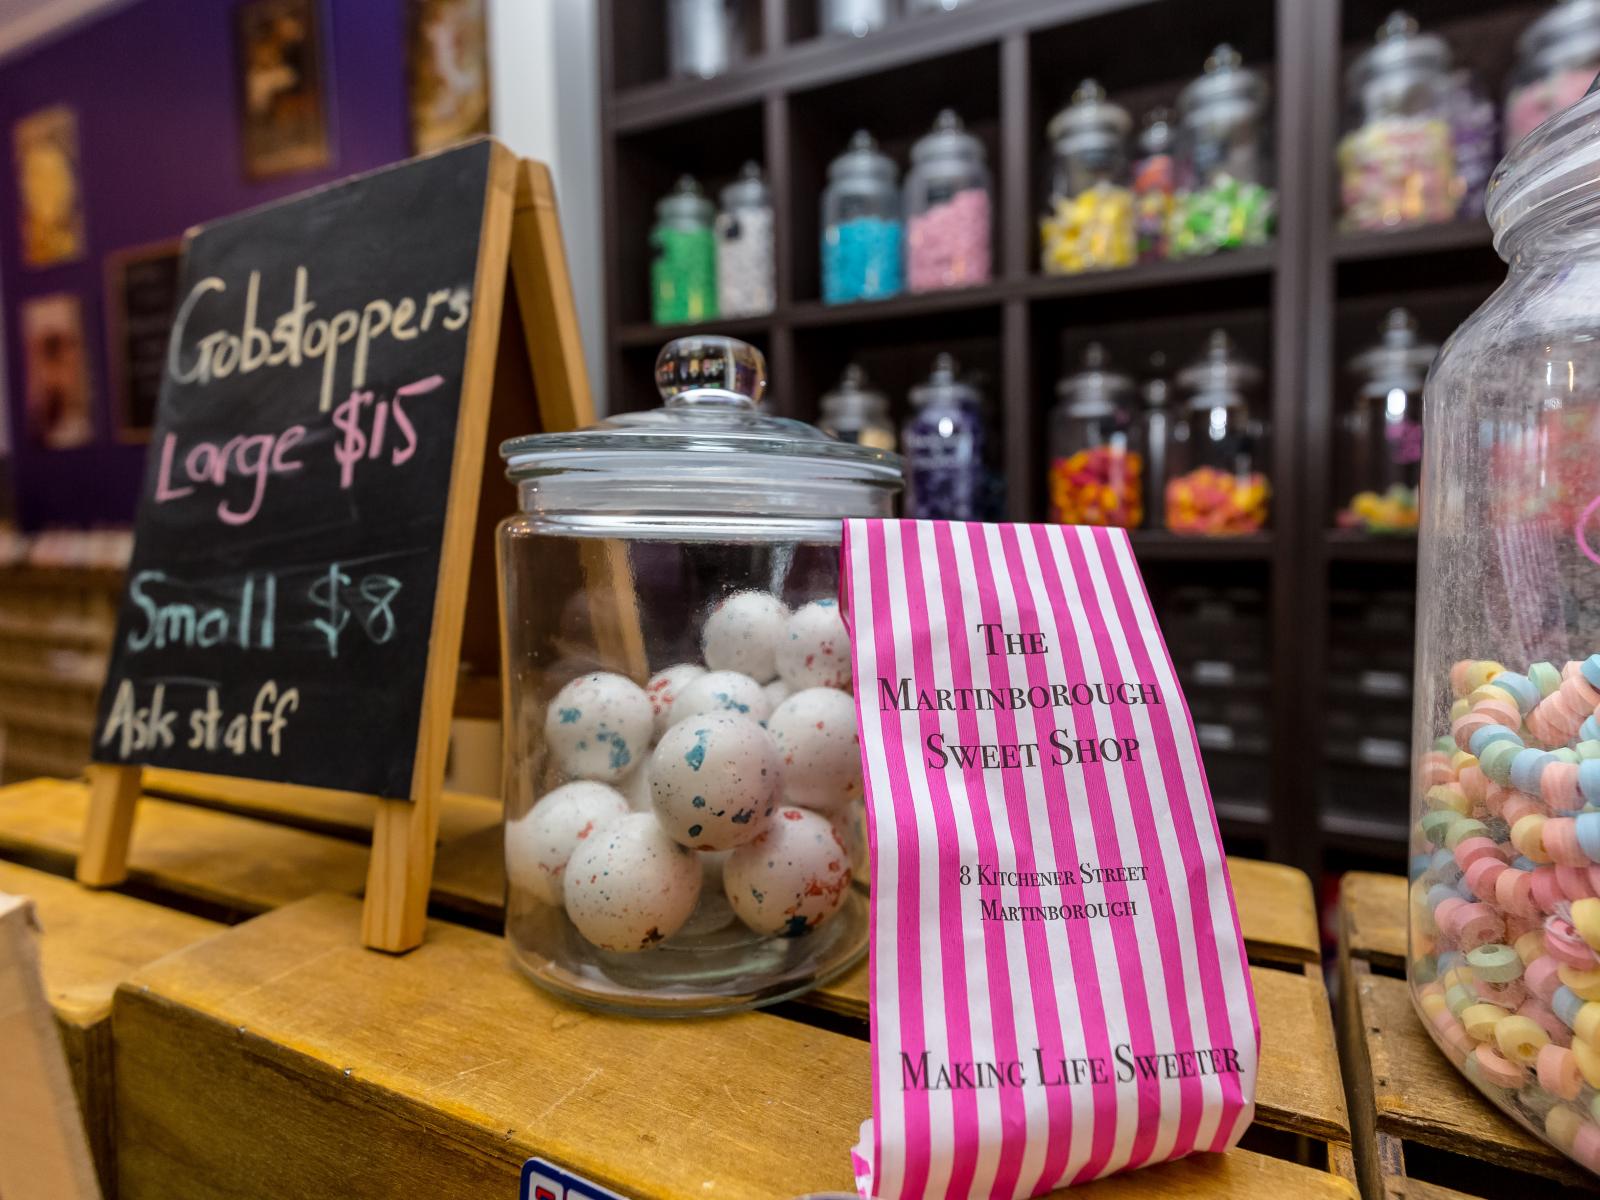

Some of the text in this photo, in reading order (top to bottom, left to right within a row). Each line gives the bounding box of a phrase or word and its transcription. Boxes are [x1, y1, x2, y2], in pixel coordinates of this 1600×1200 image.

[169, 266, 470, 412] Gobstoppers
[155, 375, 444, 525] Large $15
[127, 563, 402, 658] Small $8
[977, 623, 1049, 656] THE
[877, 677, 1162, 711] MARTINBOROUGH
[100, 679, 299, 758] Ask staff
[926, 728, 1140, 769] SWEET SHOP
[960, 862, 1148, 887] 8 KITCHENER STREET
[979, 899, 1138, 921] MARTINBOROUGH
[899, 1043, 1245, 1091] MAKING LIFE SWEETER
